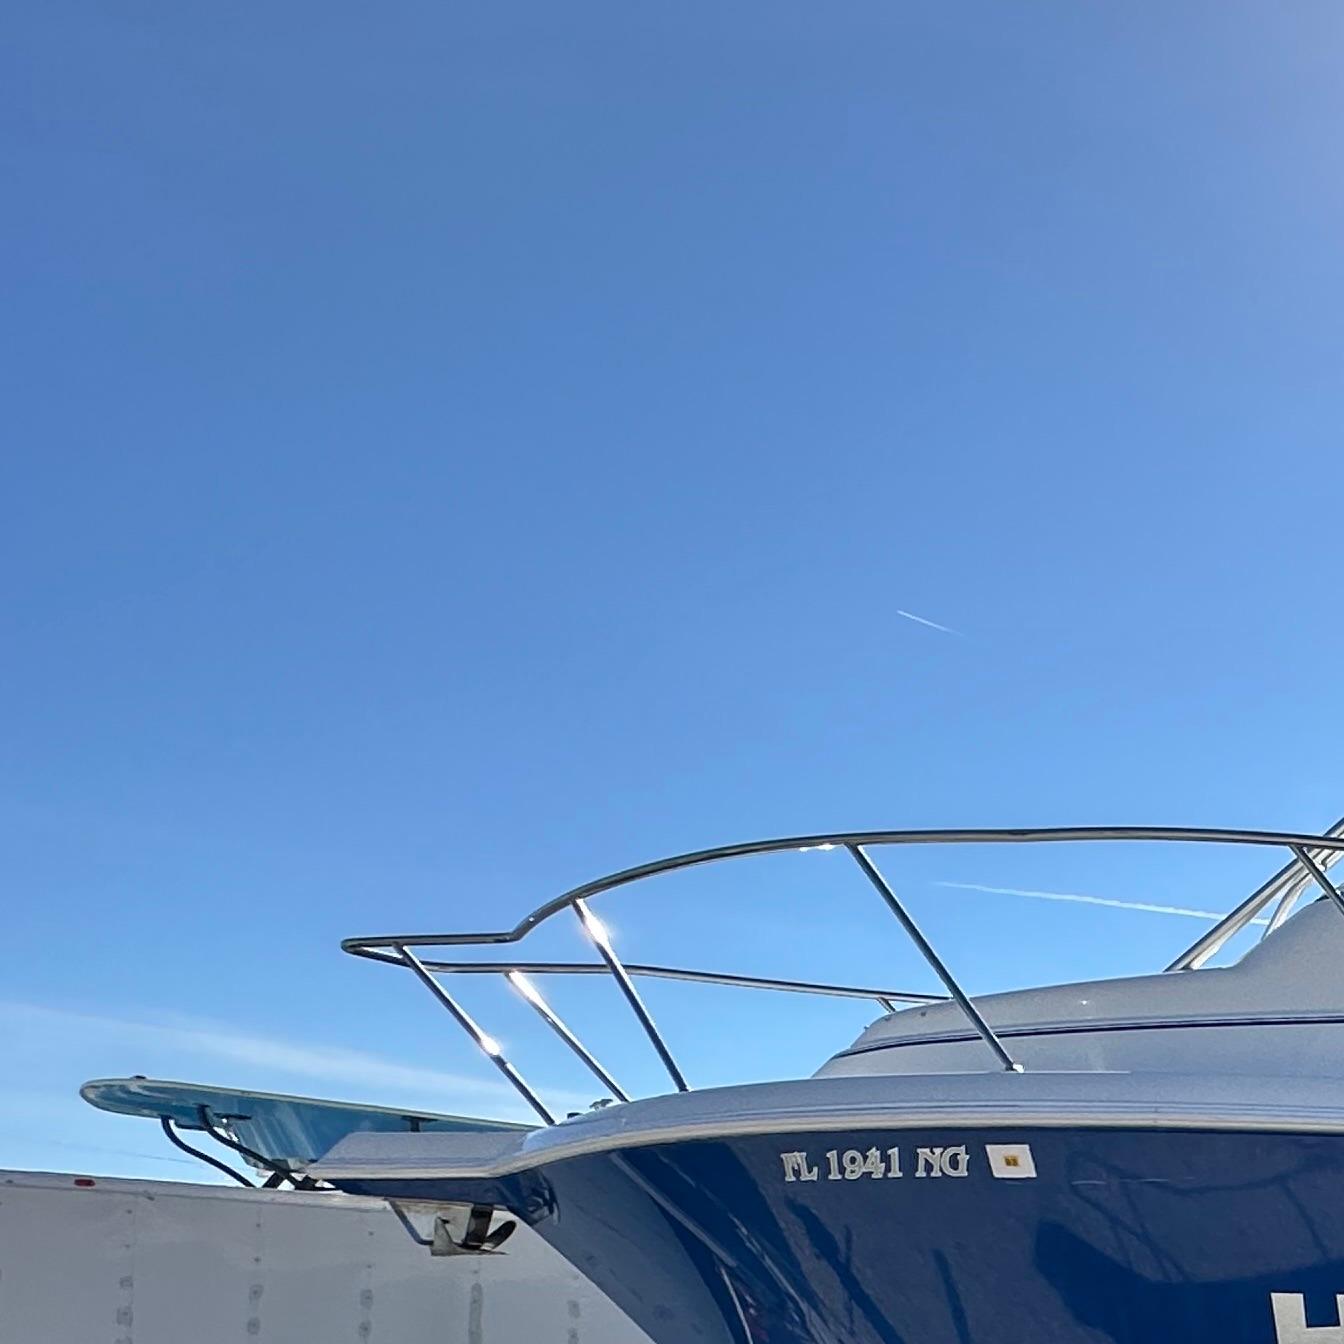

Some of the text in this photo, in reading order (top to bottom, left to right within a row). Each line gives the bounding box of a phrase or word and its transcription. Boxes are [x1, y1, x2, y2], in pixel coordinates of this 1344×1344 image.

[780, 1151, 819, 1182] FL
[826, 1146, 903, 1180] 1941
[915, 1144, 970, 1178] NG
